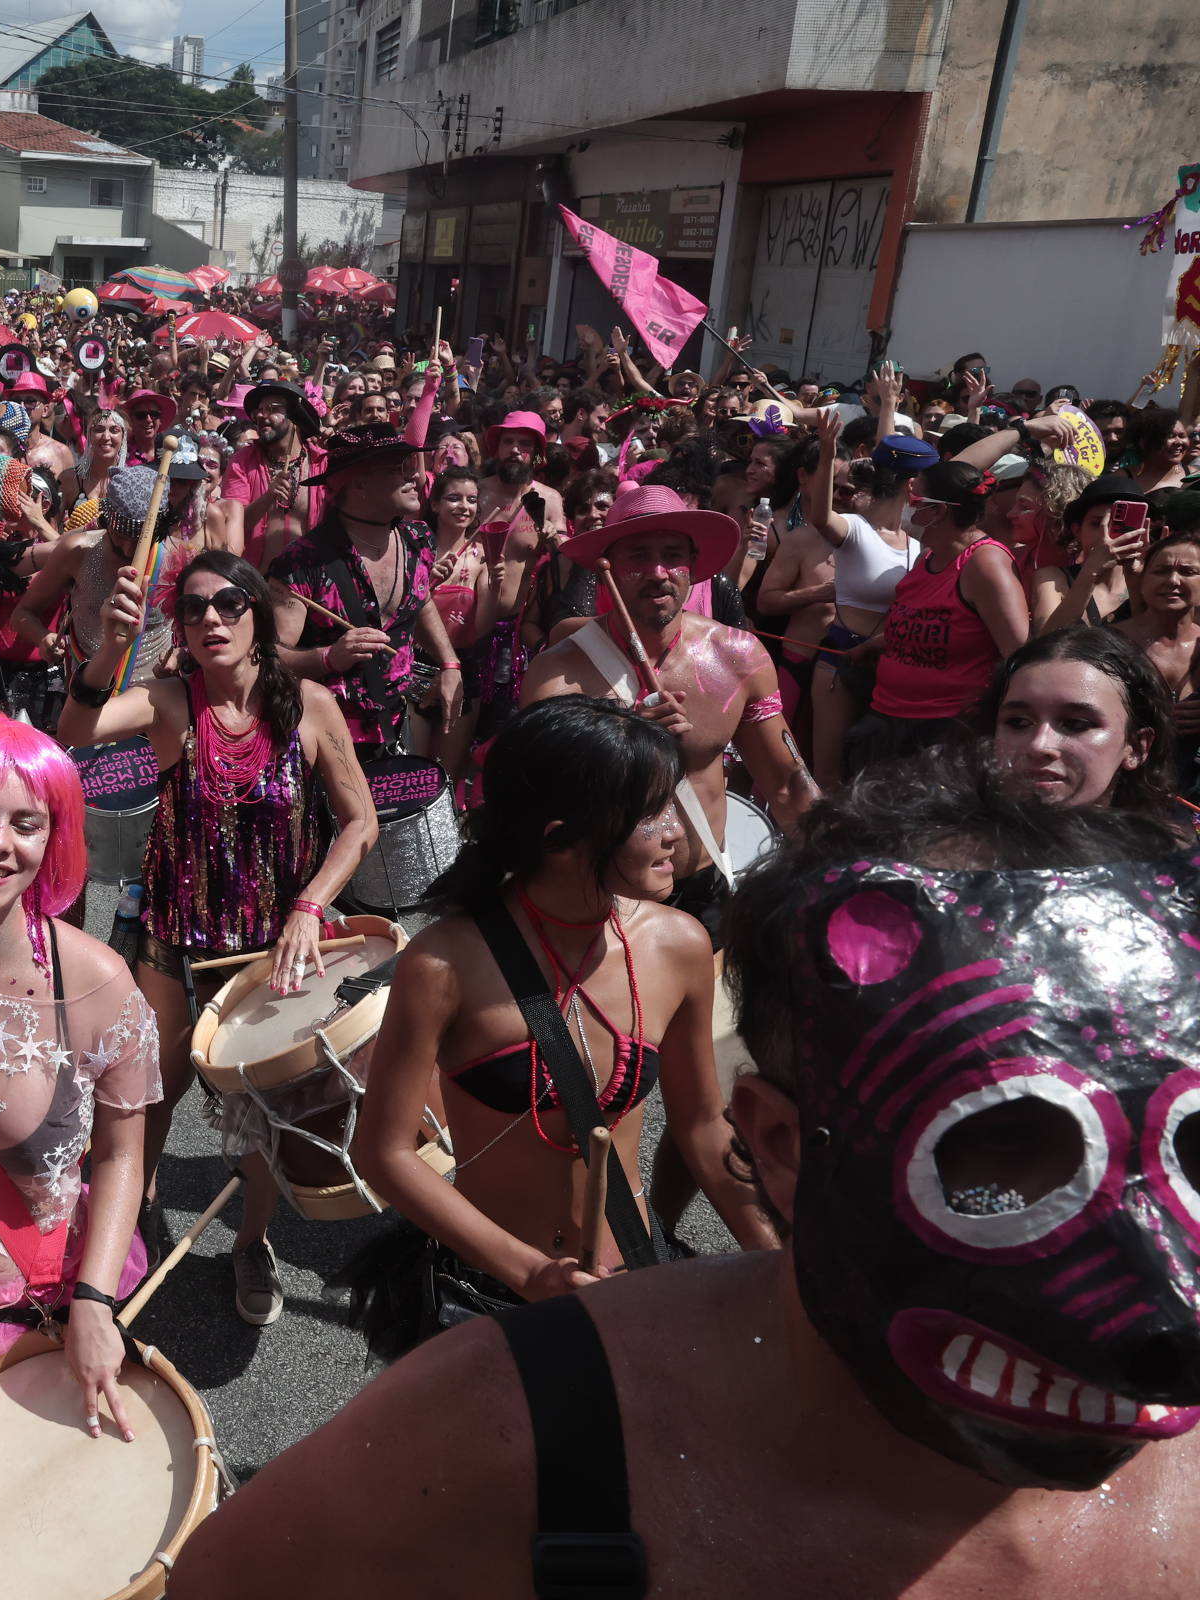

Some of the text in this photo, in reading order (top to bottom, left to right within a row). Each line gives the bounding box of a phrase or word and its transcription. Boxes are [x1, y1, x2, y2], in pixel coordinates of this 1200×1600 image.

[140, 745, 154, 755] EU
[100, 759, 132, 773] ESSE
[374, 767, 439, 783] PASSADO
[371, 774, 439, 792] MORRI
[406, 783, 438, 794] ANO
[388, 790, 438, 803] MORRO
